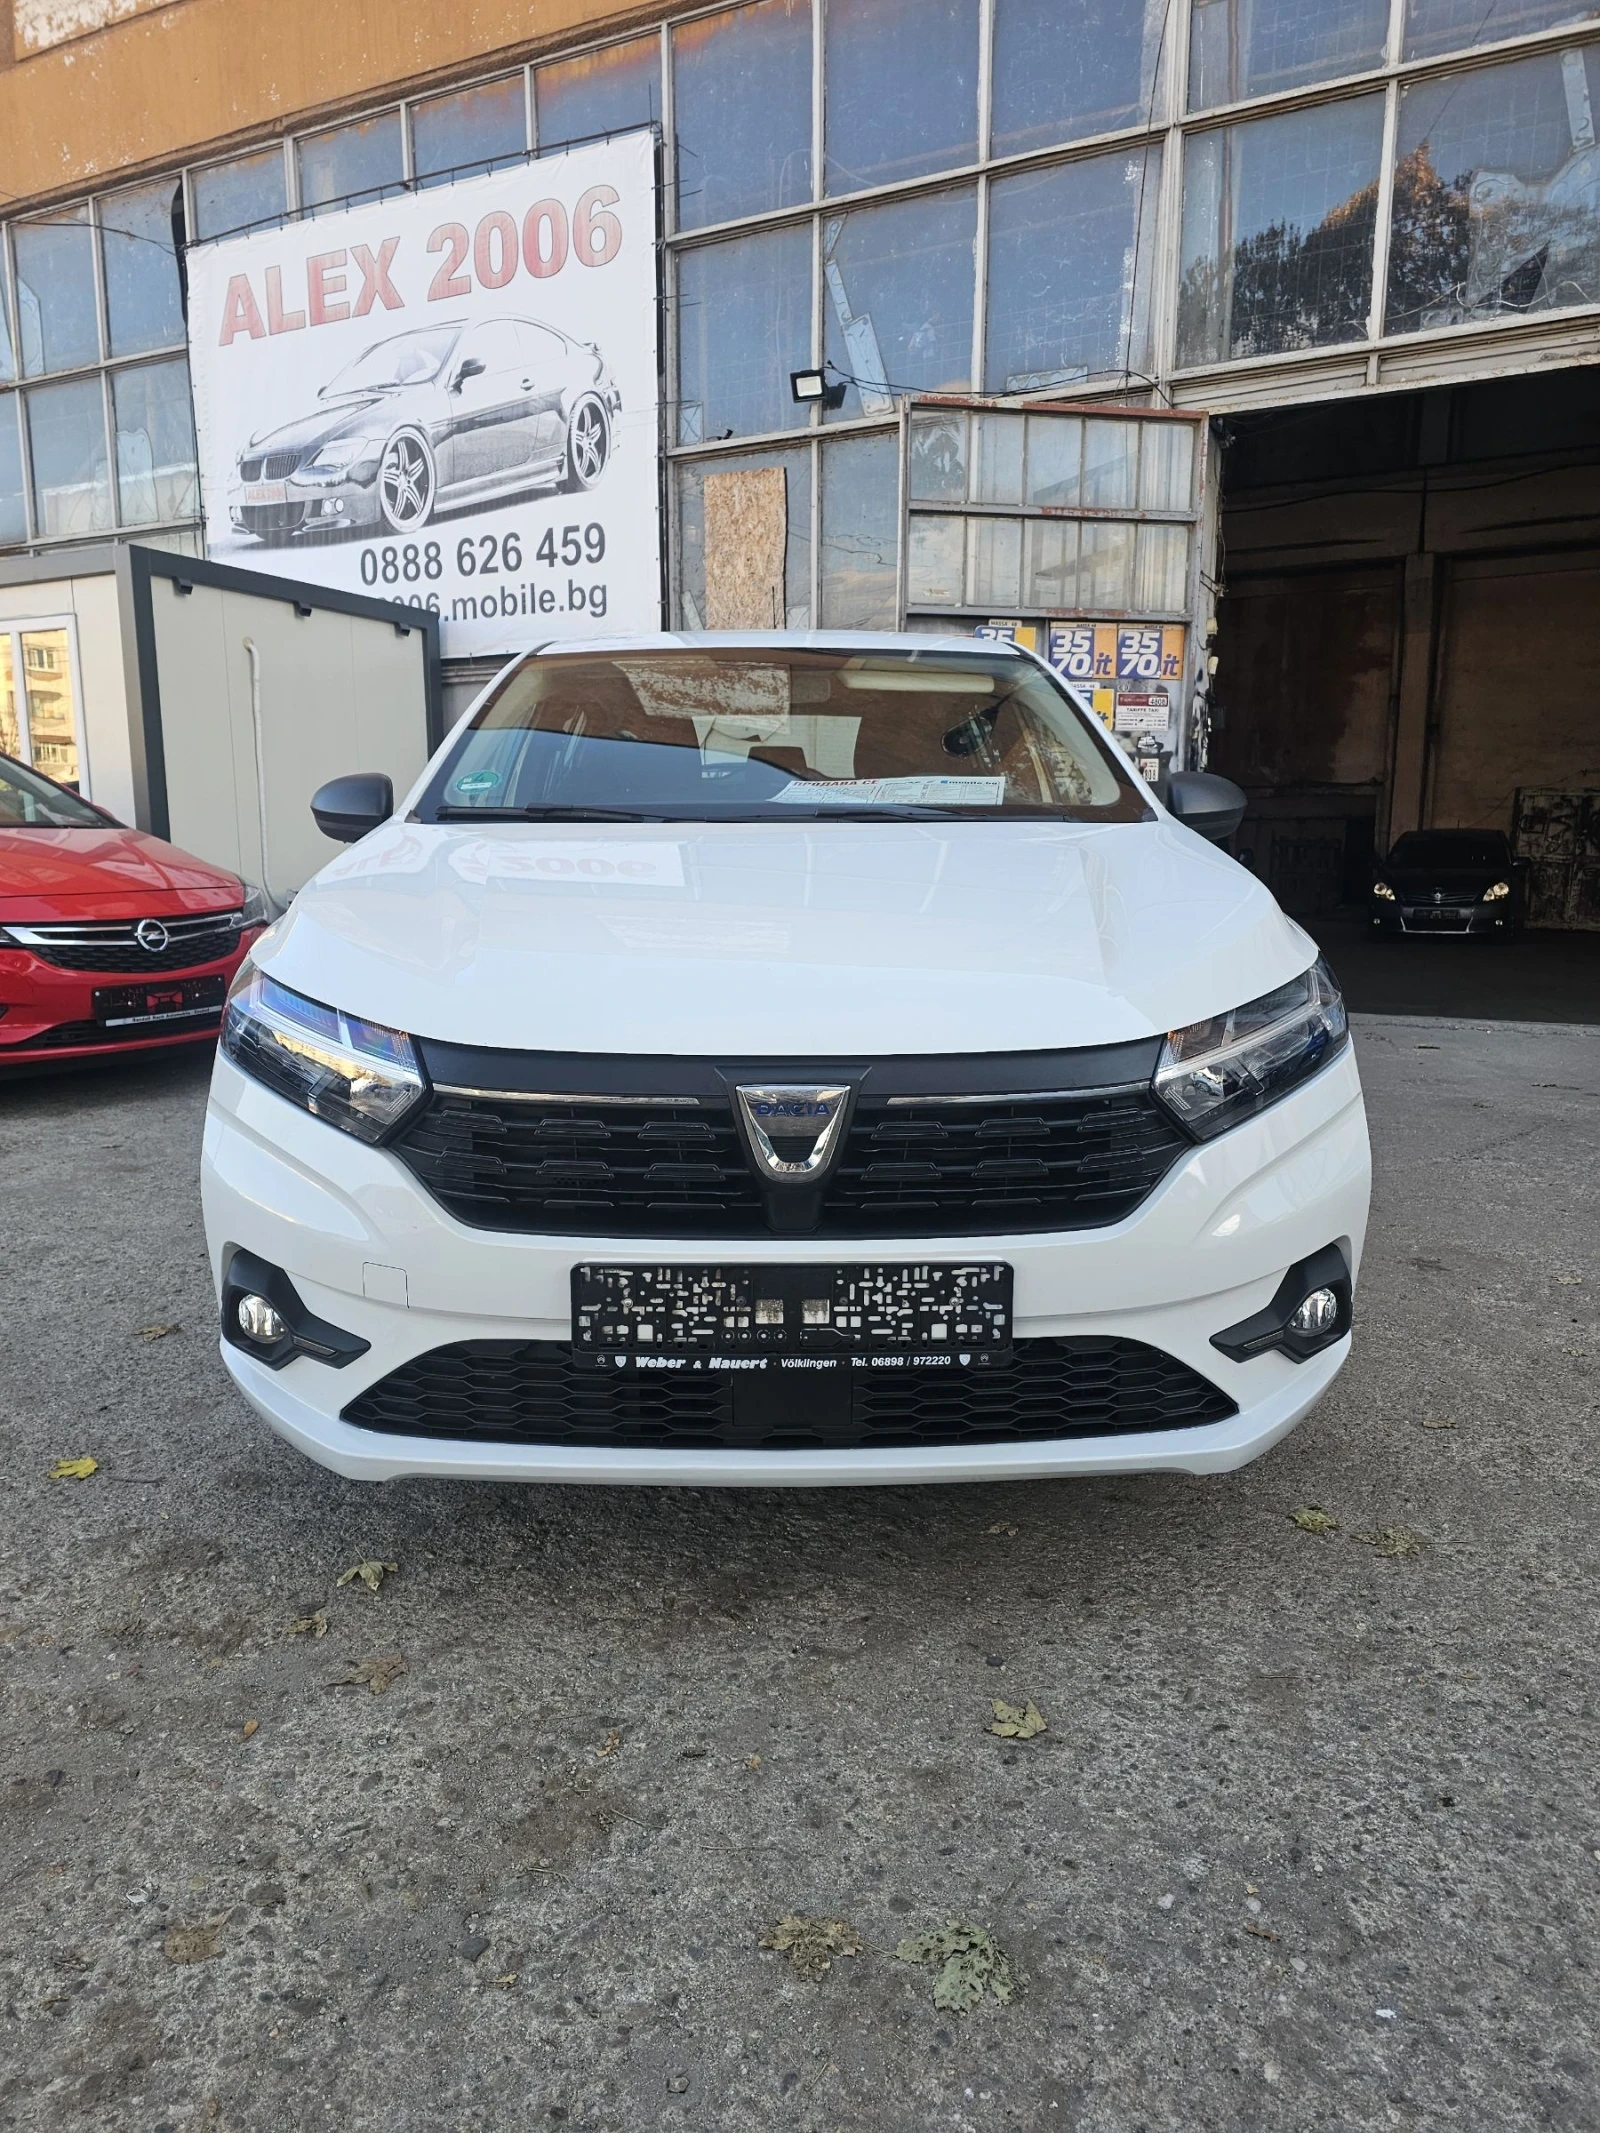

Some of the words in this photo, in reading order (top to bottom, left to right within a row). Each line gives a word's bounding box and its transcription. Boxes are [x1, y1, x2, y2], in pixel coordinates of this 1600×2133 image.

[219, 236, 406, 347] ALEX
[426, 184, 623, 303] 2006
[360, 541, 443, 586] 0888
[456, 531, 523, 577] 626
[535, 522, 606, 568] 459
[379, 579, 608, 621] 06.mobile.bg
[1052, 630, 1092, 653] 35
[1121, 631, 1160, 654] 35
[757, 1102, 831, 1116] DACIA
[635, 1356, 686, 1369] Weber
[692, 1360, 702, 1369] &
[708, 1357, 768, 1369] Nauert
[780, 1357, 838, 1370] Völklingen
[850, 1357, 868, 1367] Tel.
[871, 1356, 904, 1367] 06898
[912, 1356, 951, 1366] 972220
